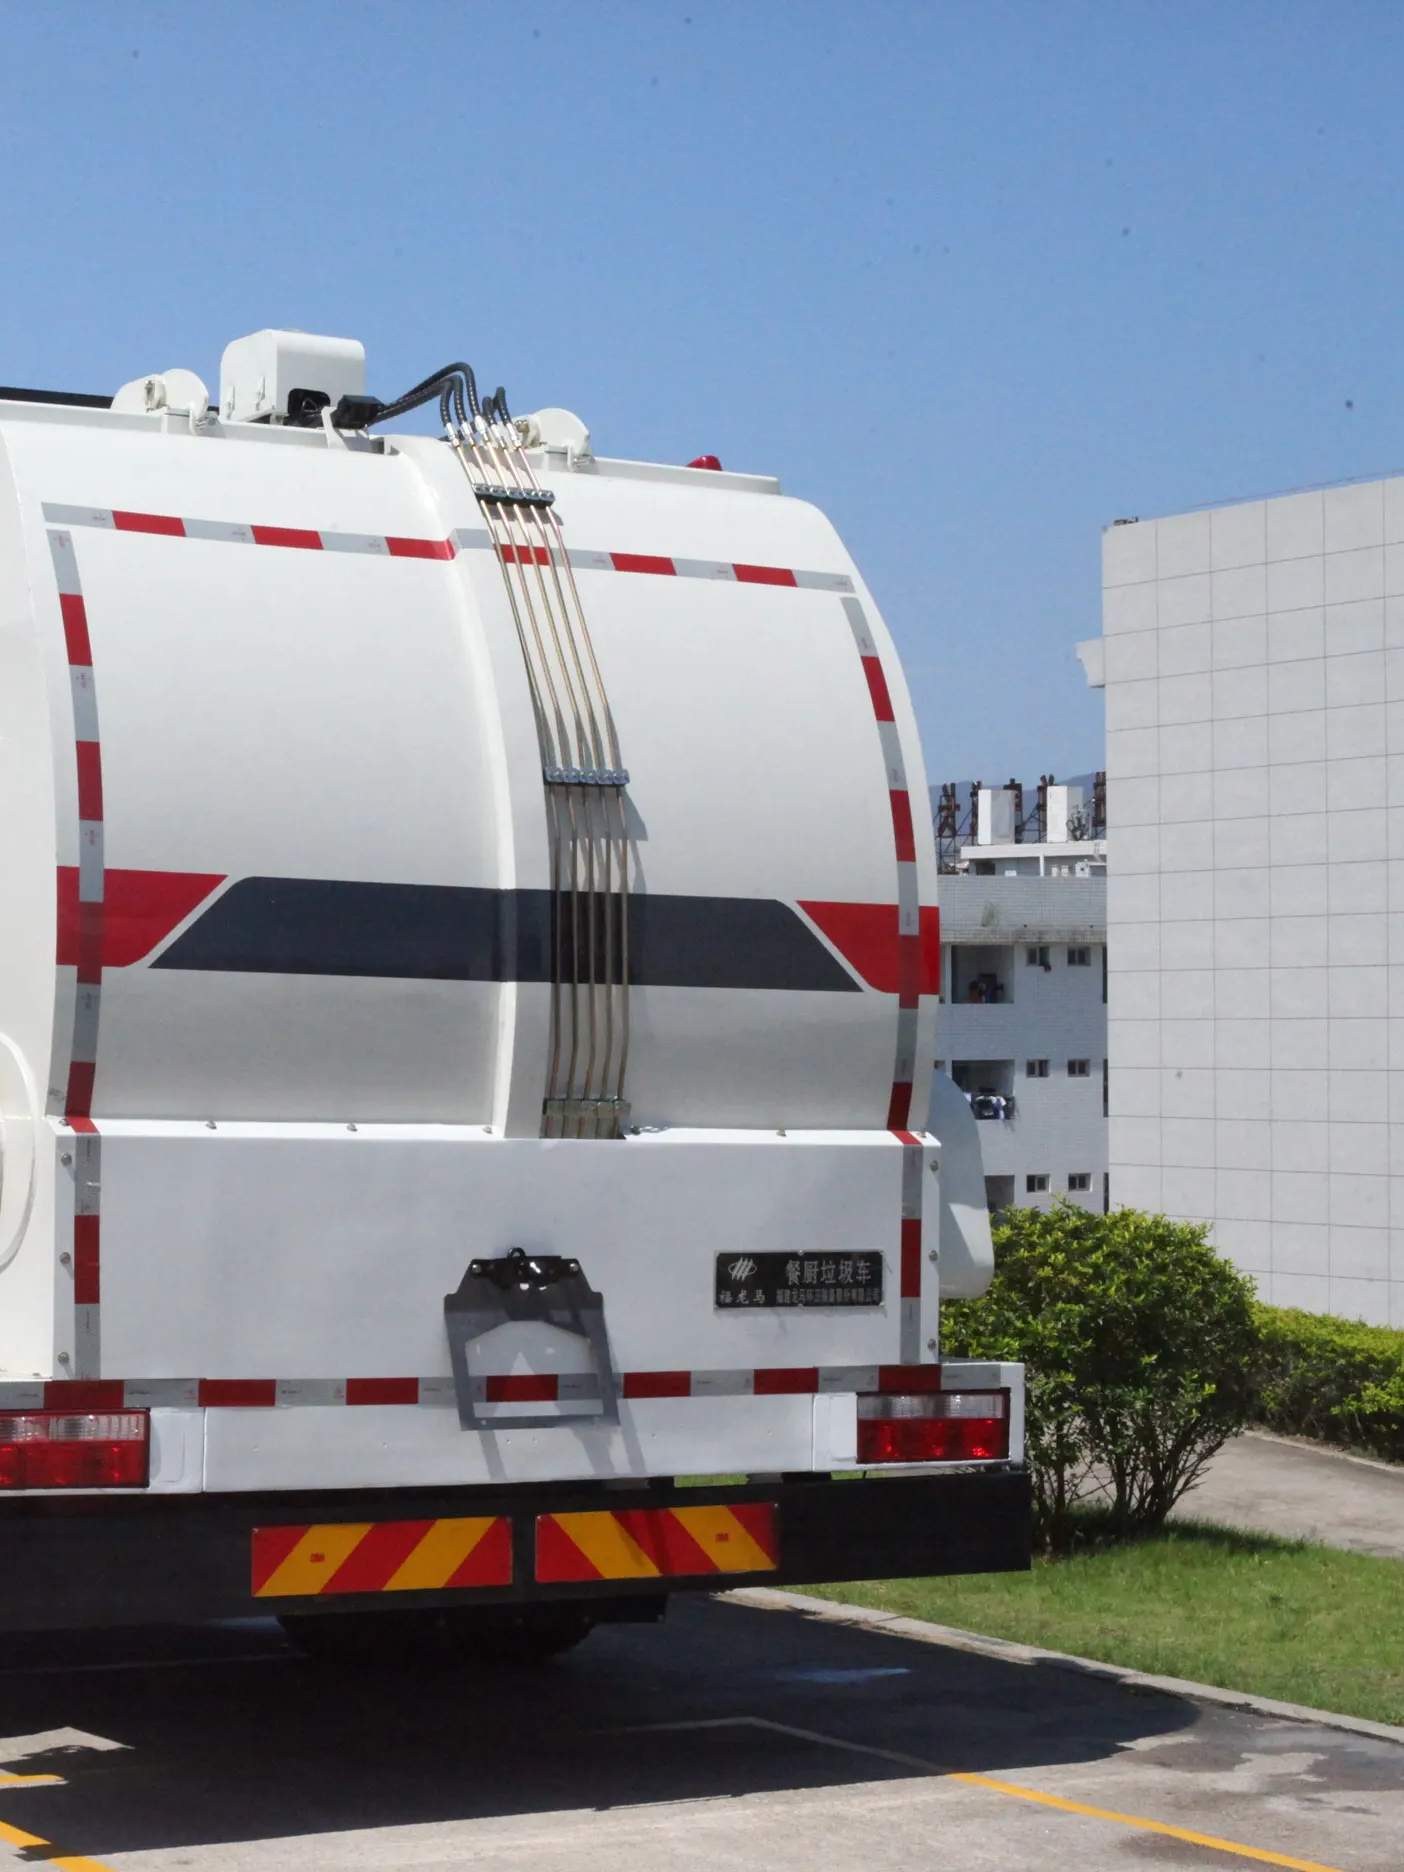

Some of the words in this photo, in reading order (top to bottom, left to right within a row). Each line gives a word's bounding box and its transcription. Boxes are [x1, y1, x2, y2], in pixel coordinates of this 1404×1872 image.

[785, 1259, 871, 1285] 餐厨垃圾车
[718, 1290, 767, 1305] 福龙马
